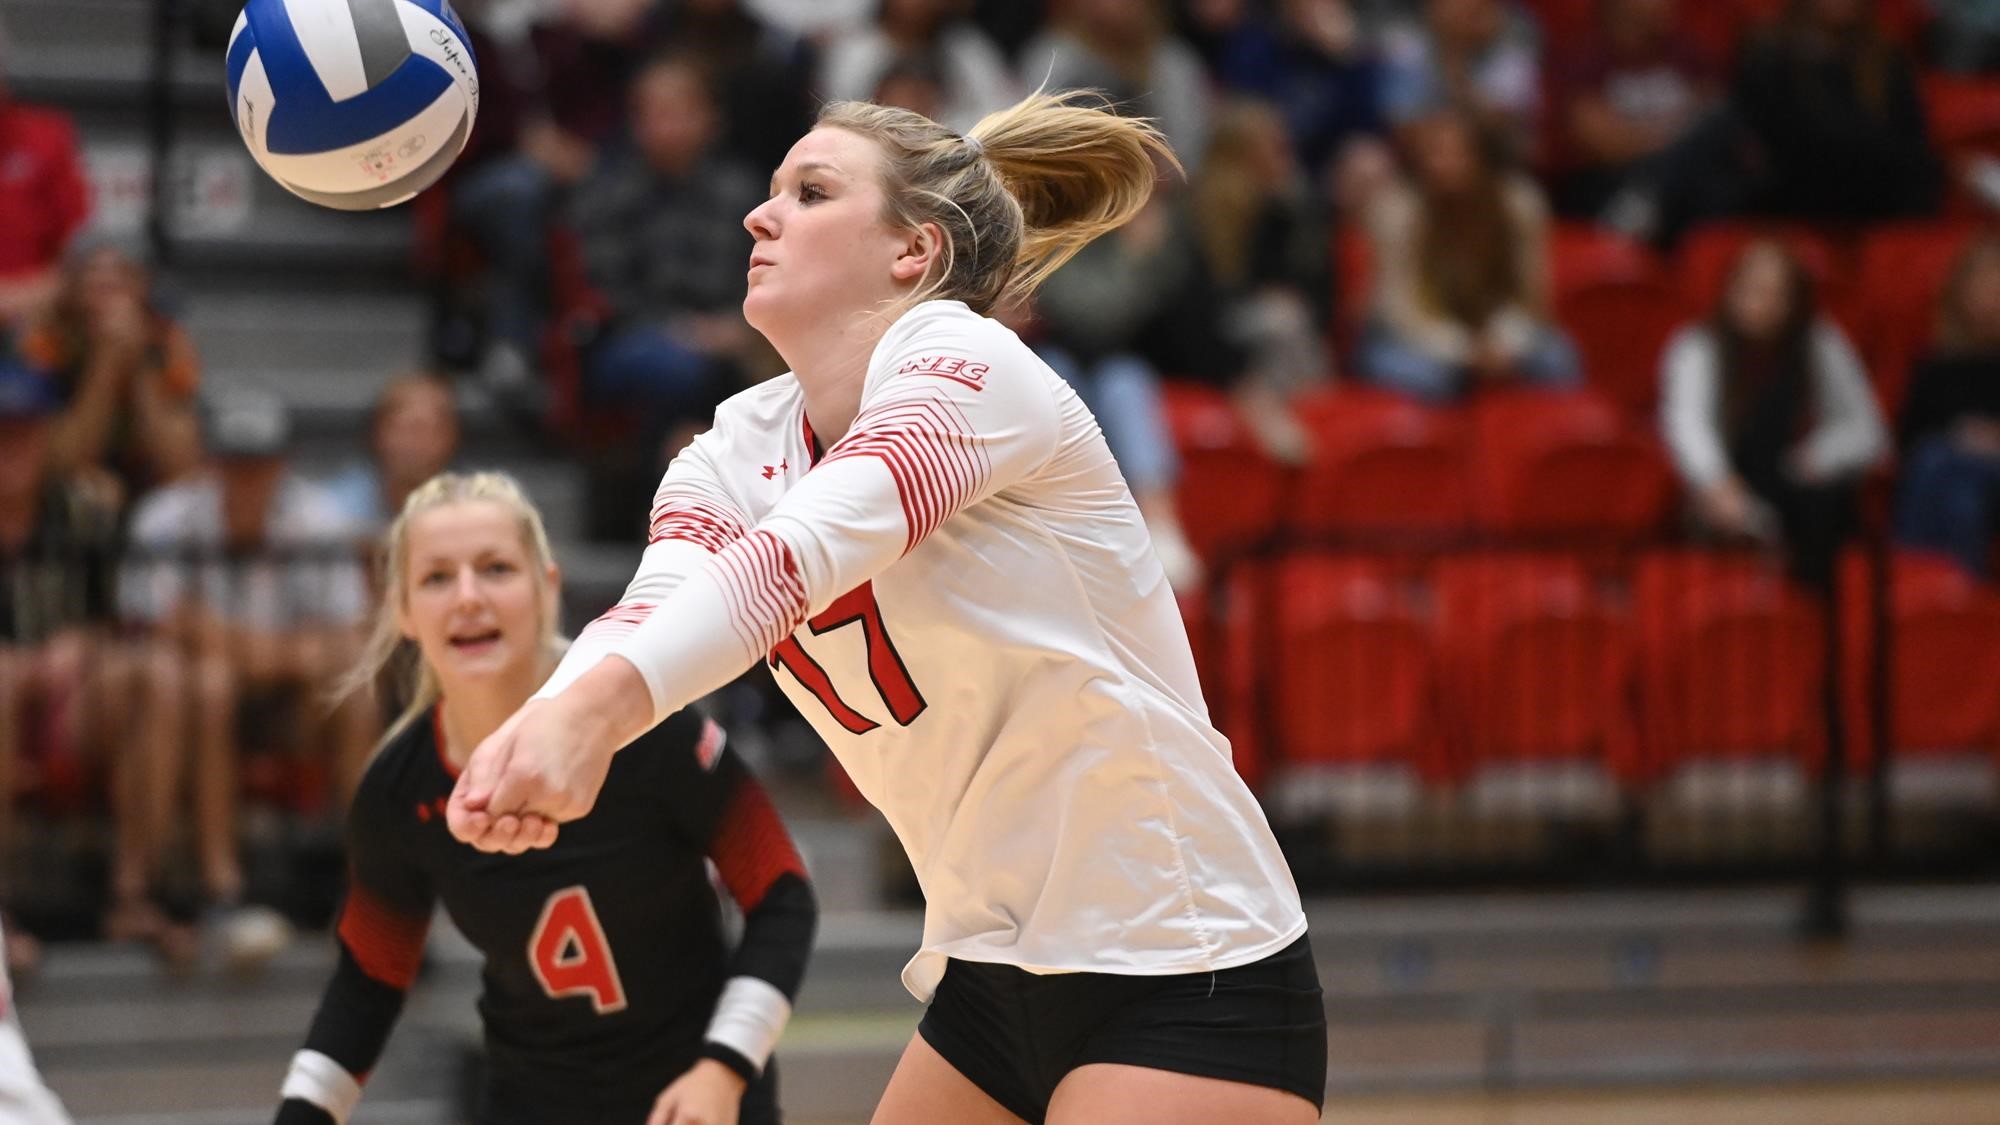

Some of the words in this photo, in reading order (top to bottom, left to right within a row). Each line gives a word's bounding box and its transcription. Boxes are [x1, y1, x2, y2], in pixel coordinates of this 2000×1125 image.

[430, 28, 467, 75] Super
[769, 578, 929, 736] 17
[527, 884, 628, 1015] 4
